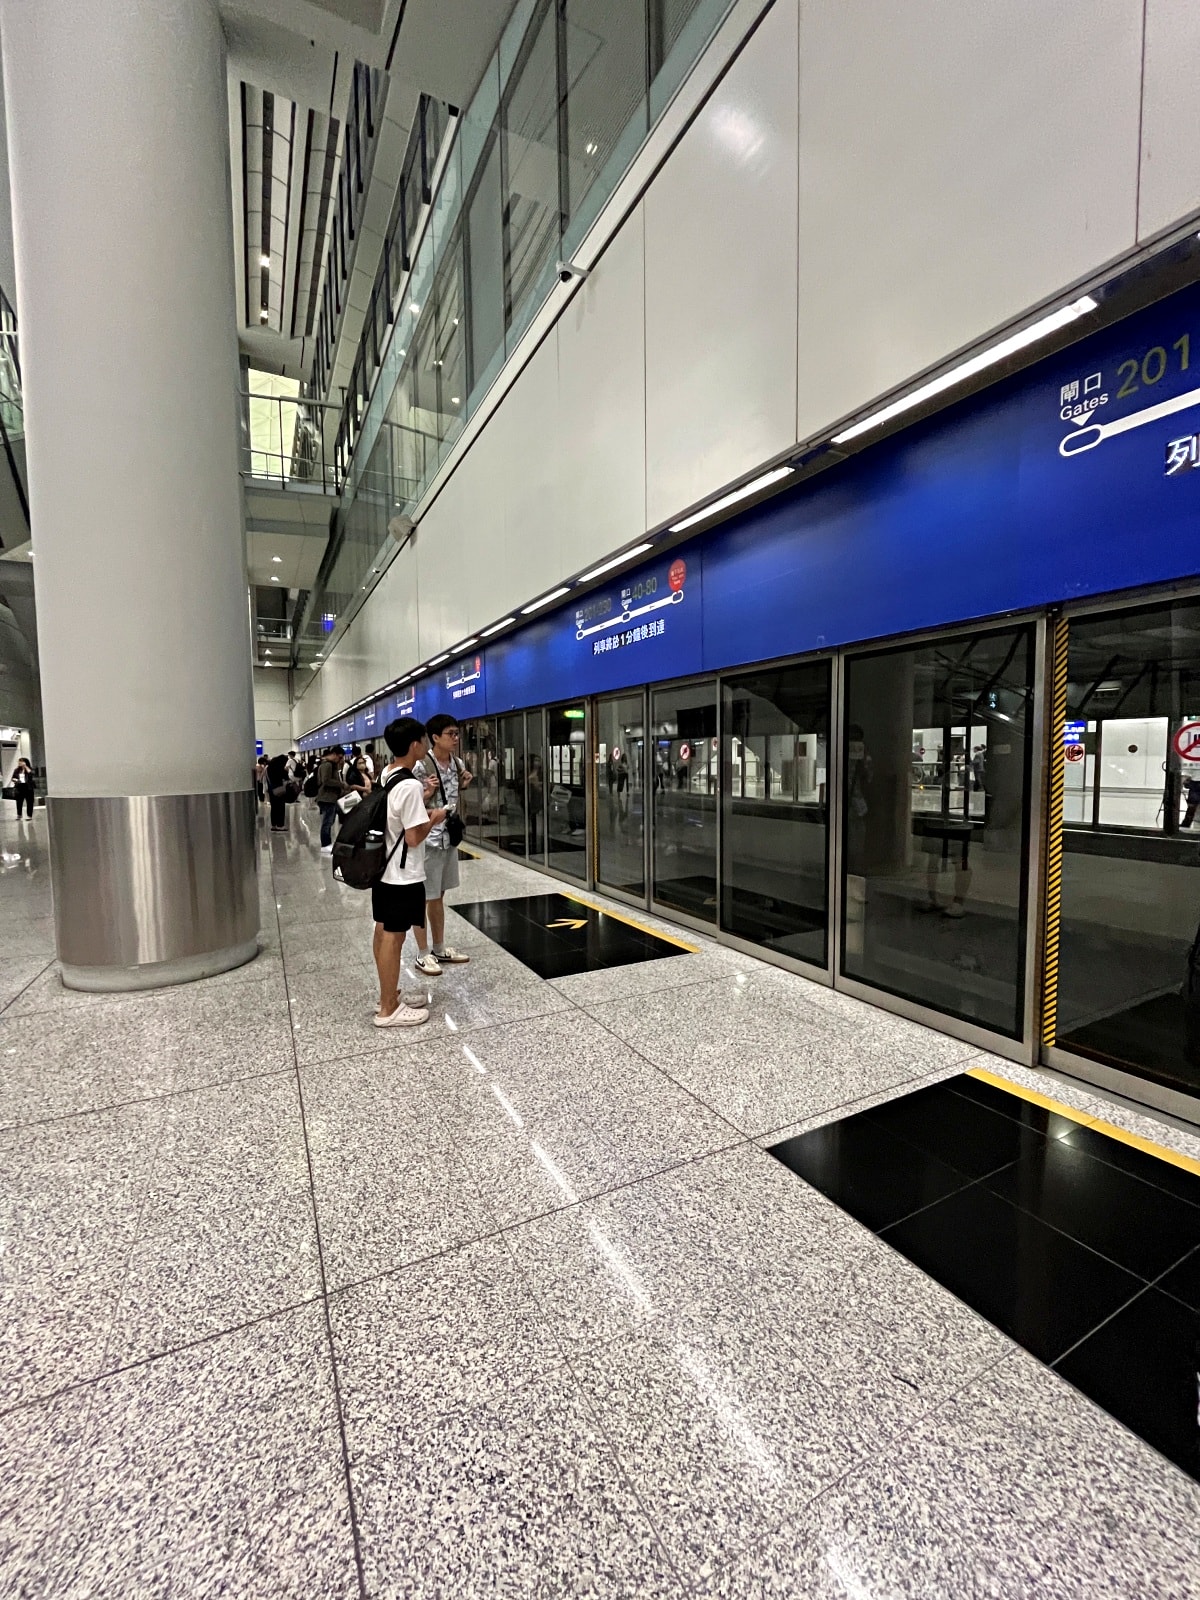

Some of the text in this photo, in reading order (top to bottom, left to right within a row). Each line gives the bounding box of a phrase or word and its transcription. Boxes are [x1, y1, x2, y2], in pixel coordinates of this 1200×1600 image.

[1061, 333, 1190, 406] 閘口 201
[1060, 393, 1109, 420] Gates
